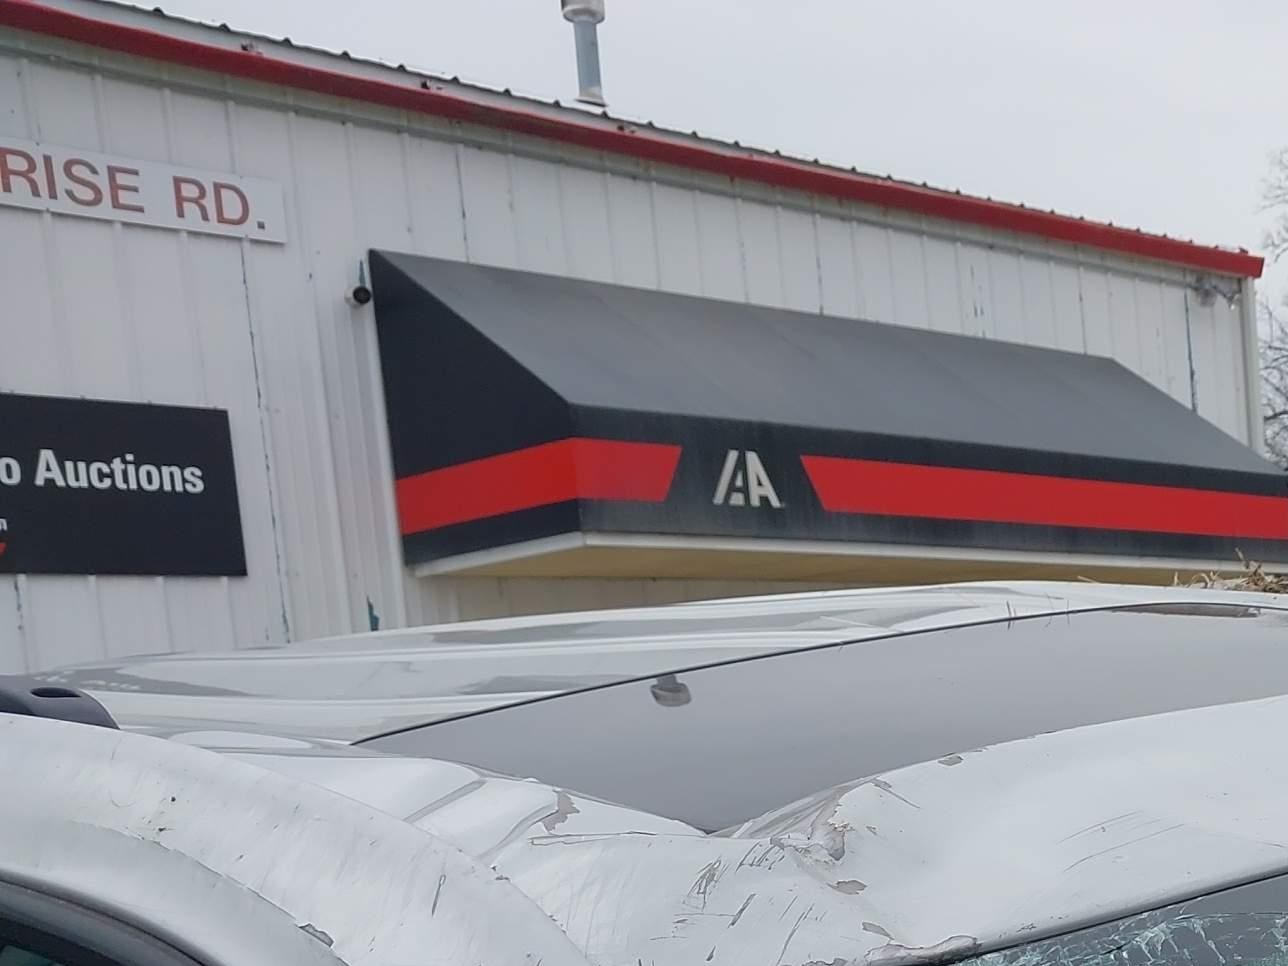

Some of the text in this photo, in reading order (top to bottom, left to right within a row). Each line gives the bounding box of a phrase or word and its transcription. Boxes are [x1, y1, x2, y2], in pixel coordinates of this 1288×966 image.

[0, 147, 266, 230] RISE RD.
[34, 448, 205, 494] Auctions
